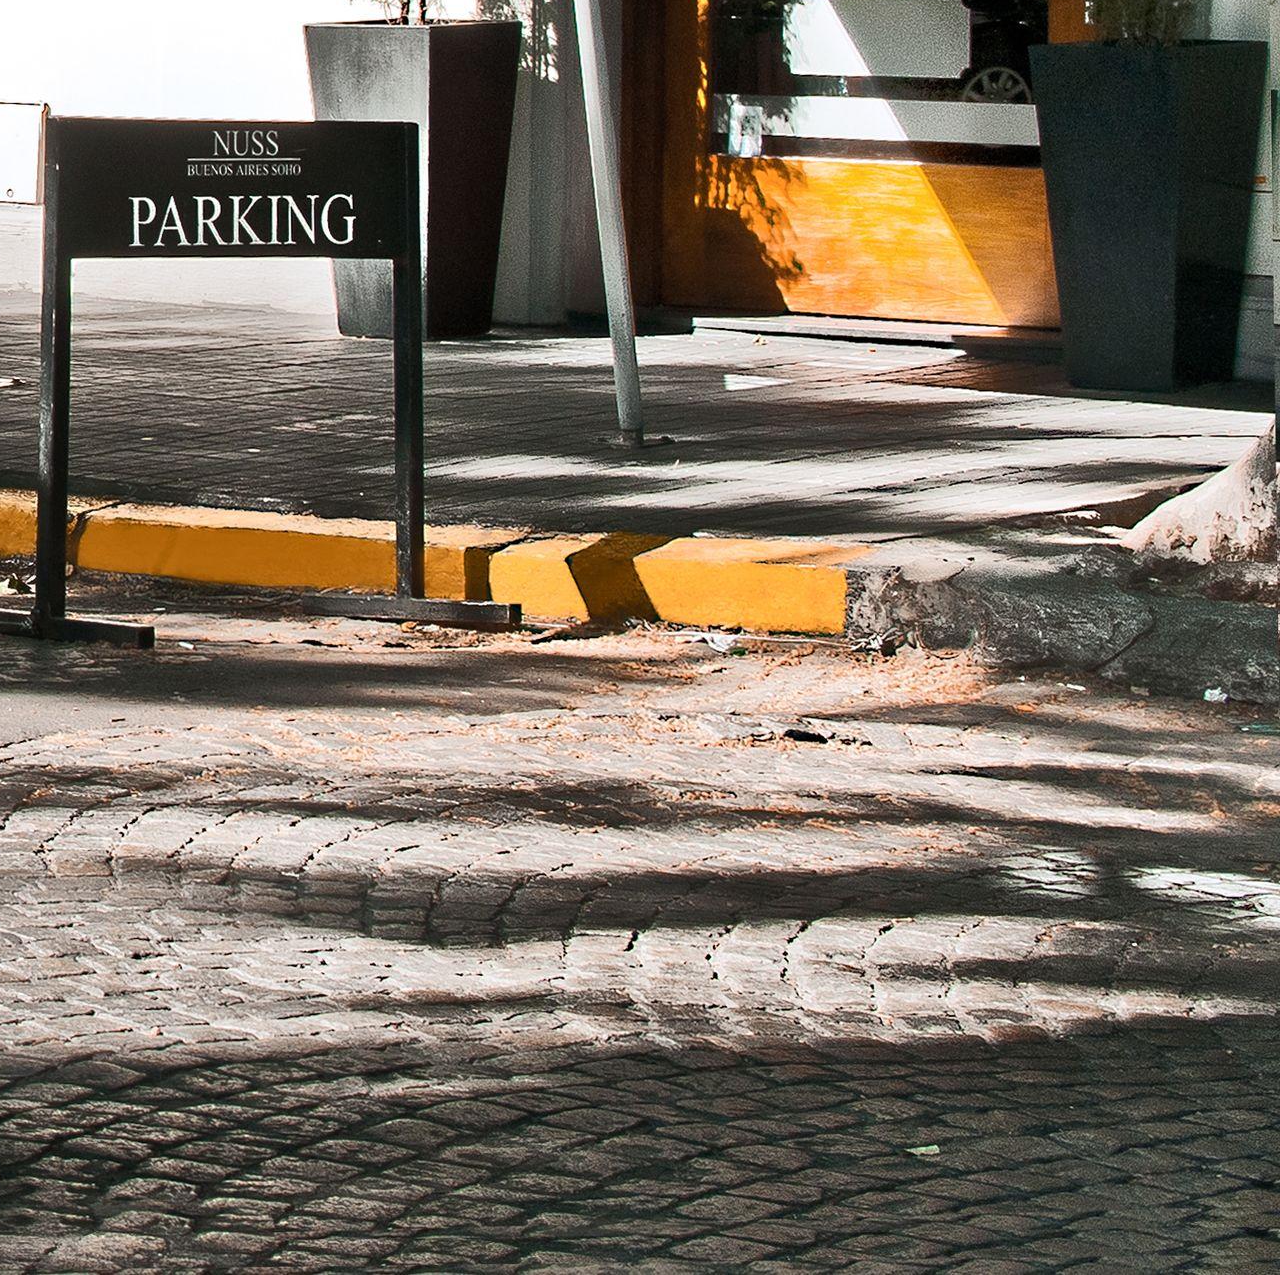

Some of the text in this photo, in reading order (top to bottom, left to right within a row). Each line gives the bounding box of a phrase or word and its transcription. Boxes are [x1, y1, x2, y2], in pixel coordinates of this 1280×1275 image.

[212, 130, 279, 156] NUSS
[186, 163, 301, 176] BUENOS AIRES SOHO
[128, 193, 357, 247] PARKING
